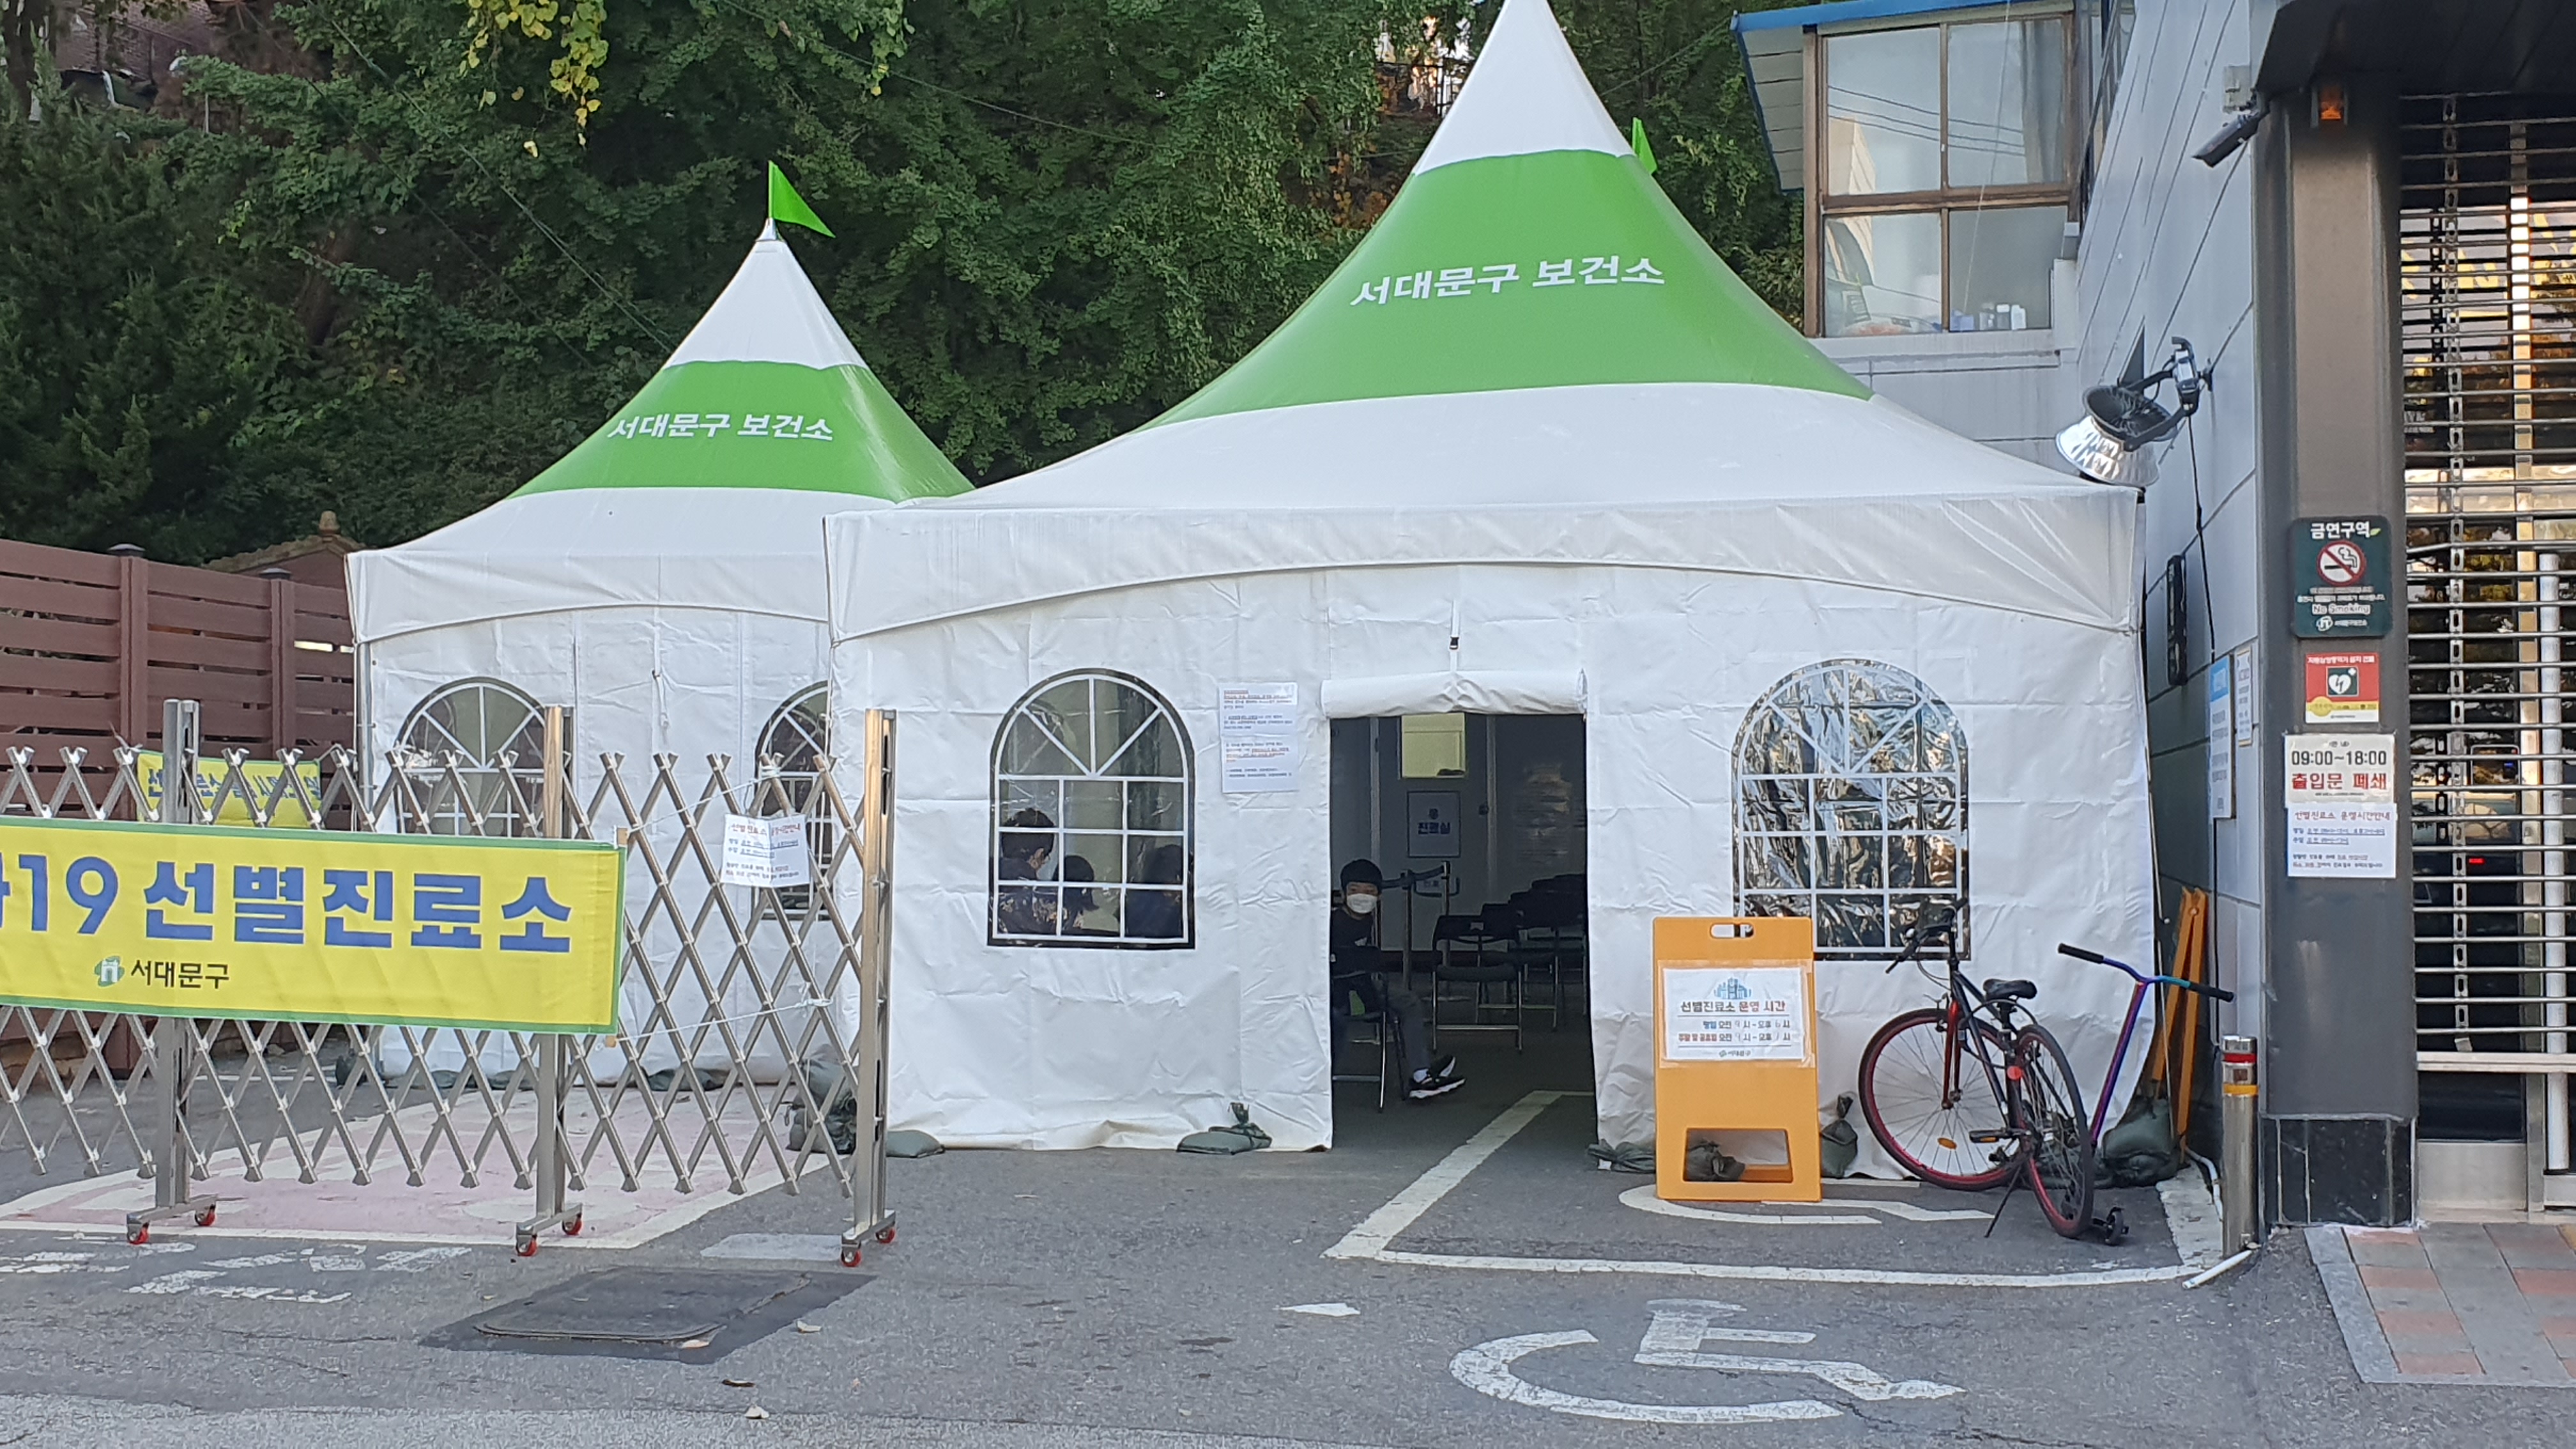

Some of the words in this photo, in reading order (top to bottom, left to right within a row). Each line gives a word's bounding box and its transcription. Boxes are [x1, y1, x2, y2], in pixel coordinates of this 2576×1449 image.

[1349, 263, 1520, 306] 서대문구
[1532, 255, 1665, 288] 보건소
[607, 413, 730, 439] 서대문구
[737, 413, 833, 441] 보건소
[2310, 521, 2370, 540] 금연구역
[2313, 604, 2327, 614] No
[2329, 603, 2370, 615] Smoking
[2291, 750, 2387, 765] 09:00~18:00
[2292, 772, 2343, 790] 출입문
[2352, 772, 2387, 790] 폐쇄
[0, 851, 119, 935] 19
[144, 860, 572, 953] 선별진료소
[130, 960, 230, 989] 서대문구
[1681, 1001, 1735, 1013] 선별진료소
[1739, 1001, 1759, 1013] 운영
[1763, 1000, 1786, 1012] 시간
[1703, 1020, 1717, 1029] 평일
[1719, 1020, 1732, 1029] 오전
[1758, 1020, 1772, 1029] 오후
[1719, 1033, 1732, 1041] 오전
[1759, 1033, 1772, 1041] 오후
